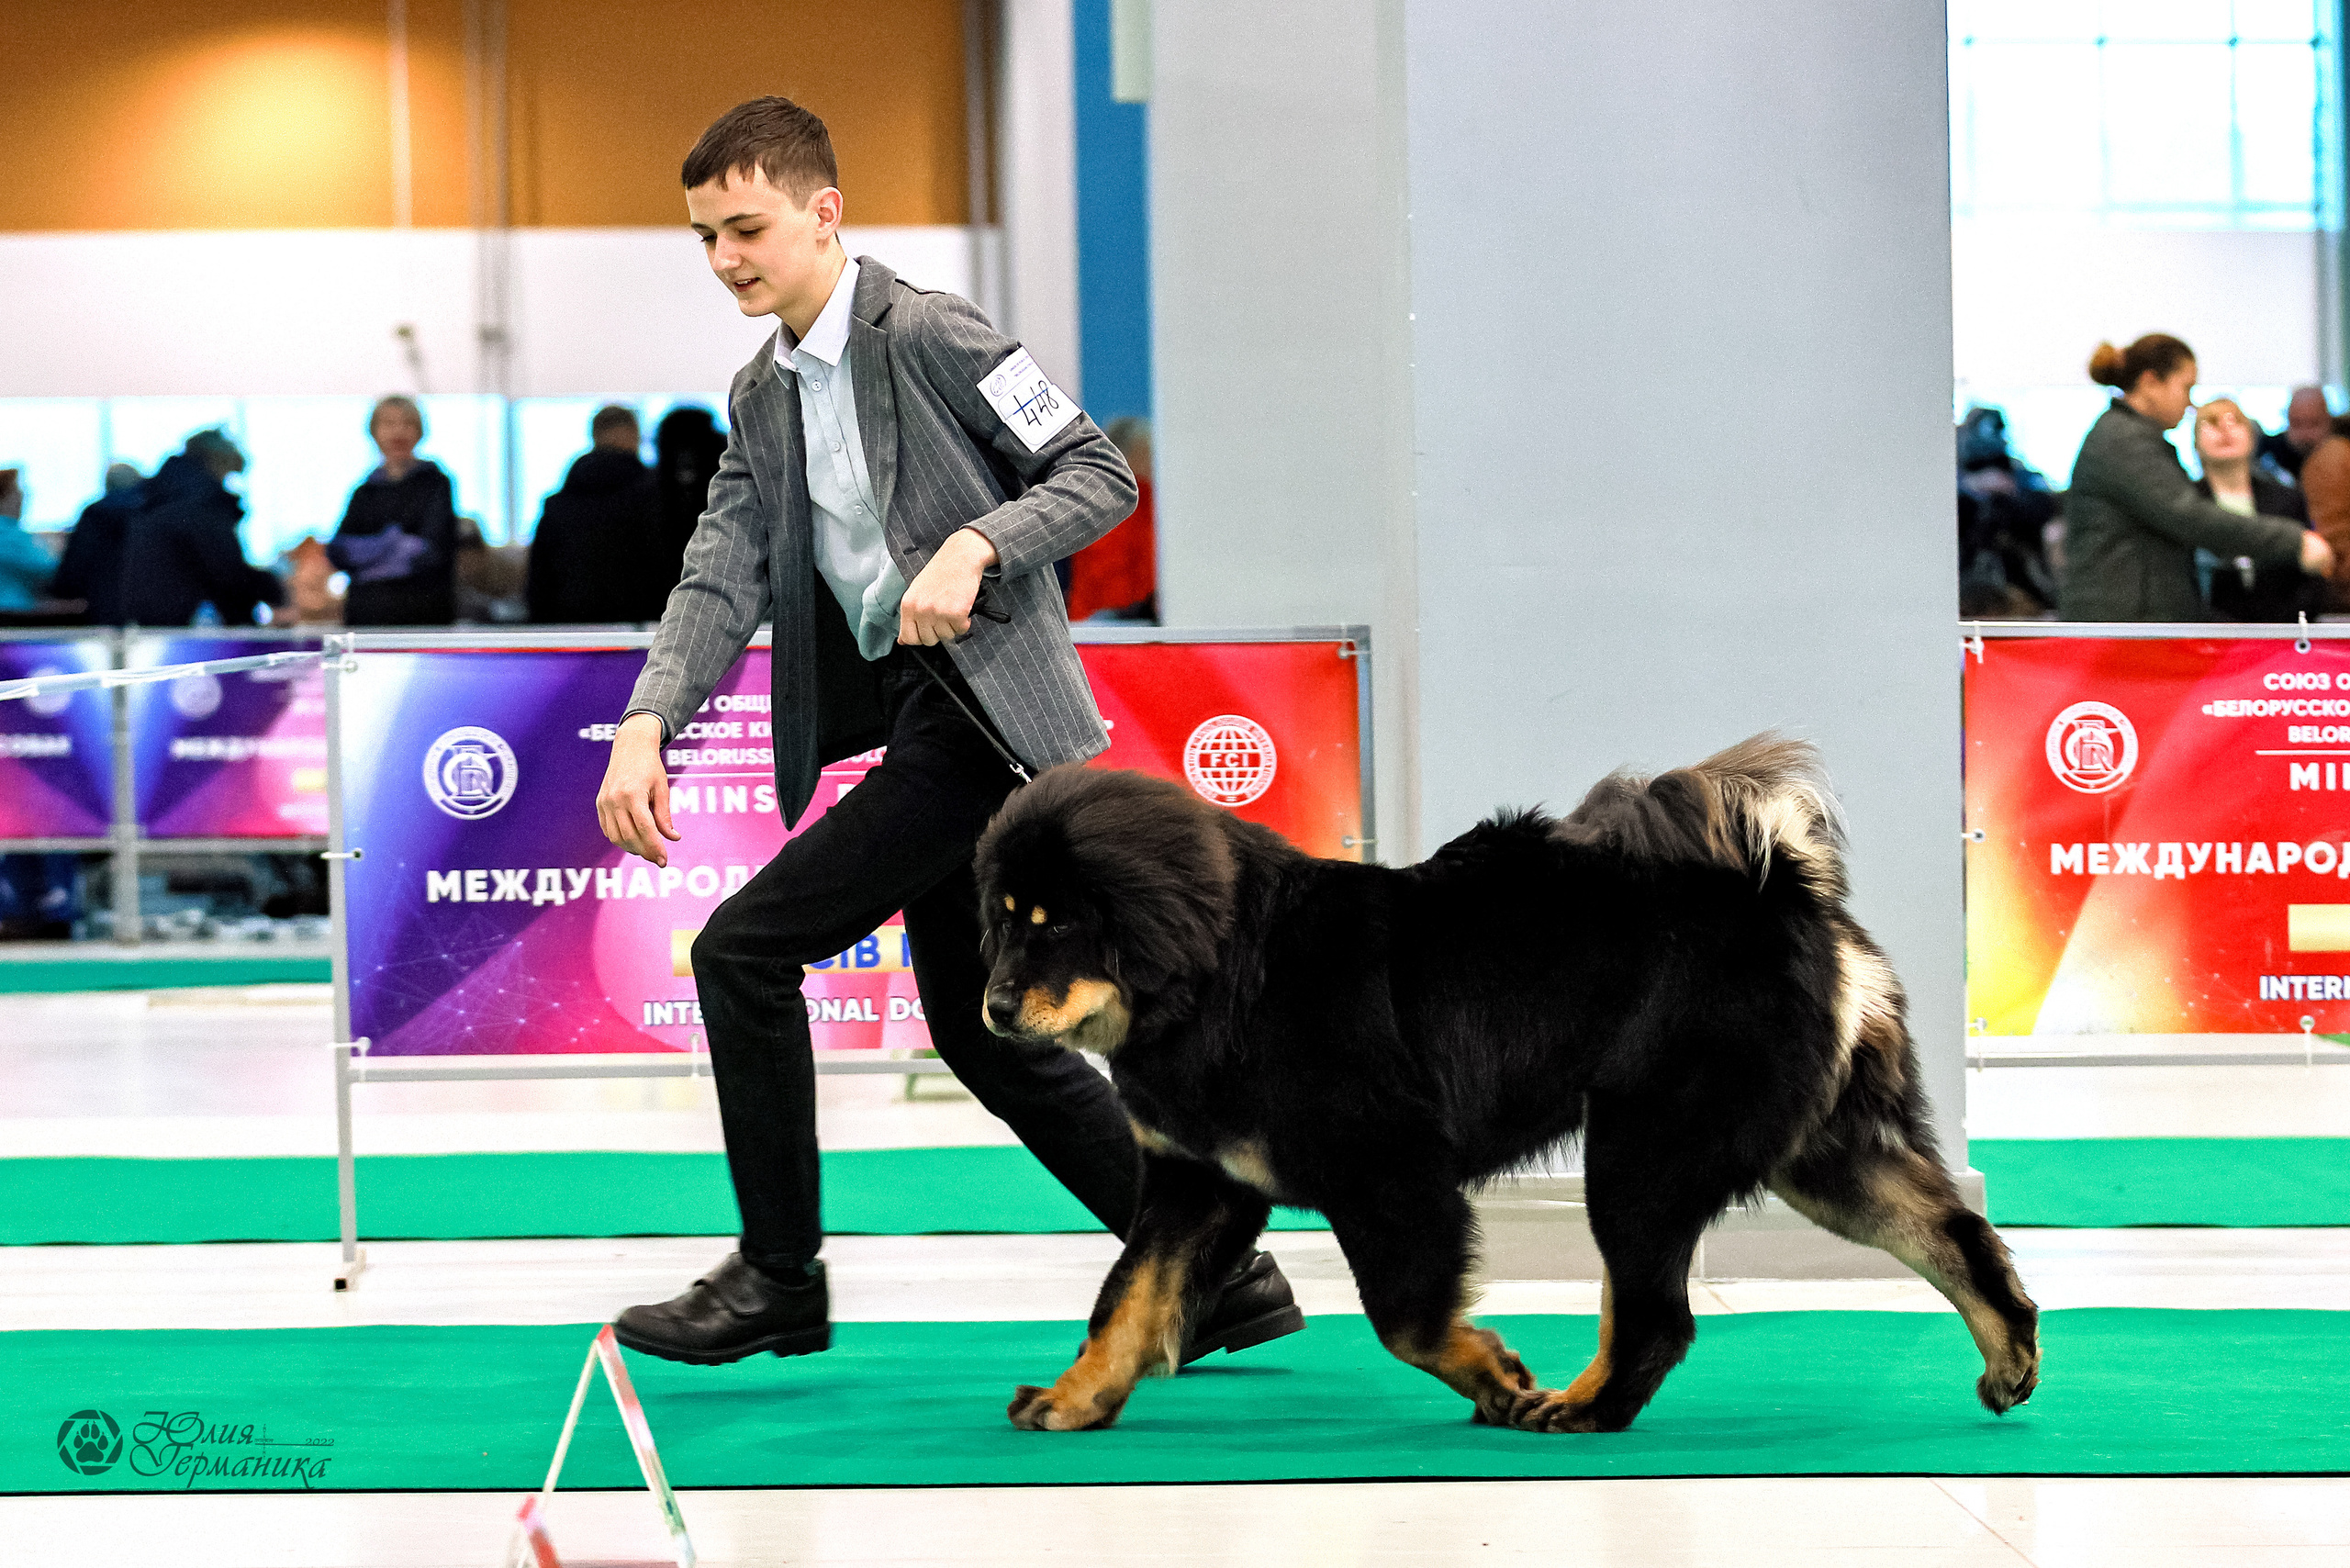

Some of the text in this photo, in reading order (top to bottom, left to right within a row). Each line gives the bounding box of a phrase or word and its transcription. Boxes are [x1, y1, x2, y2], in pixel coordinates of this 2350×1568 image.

[1012, 379, 1059, 427] 448
[2263, 672, 2332, 691] СОЮЗ
[1210, 752, 1249, 767] FCI
[426, 865, 764, 907] МЕЖДУНАРОД
